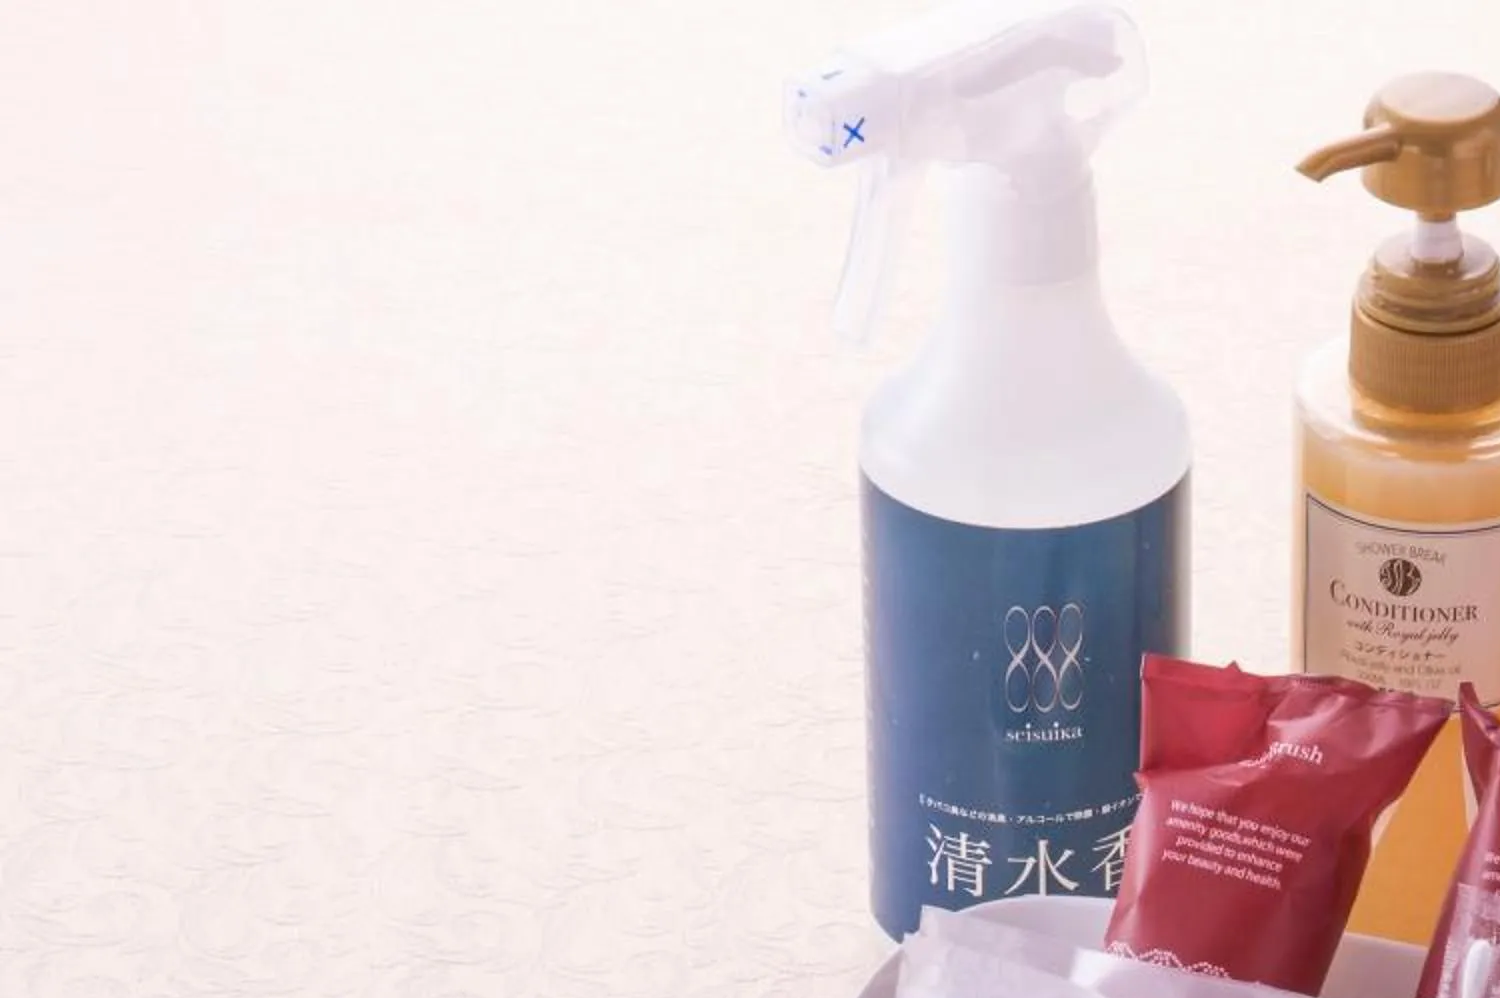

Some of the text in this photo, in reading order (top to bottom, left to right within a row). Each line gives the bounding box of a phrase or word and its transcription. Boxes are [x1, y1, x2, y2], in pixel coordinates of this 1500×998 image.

[1356, 541, 1447, 567] SHOWER BREAK
[1330, 578, 1479, 622] CONDITIONER
[1346, 620, 1373, 633] with
[1375, 622, 1424, 643] Royal
[1006, 720, 1083, 741] seisuika
